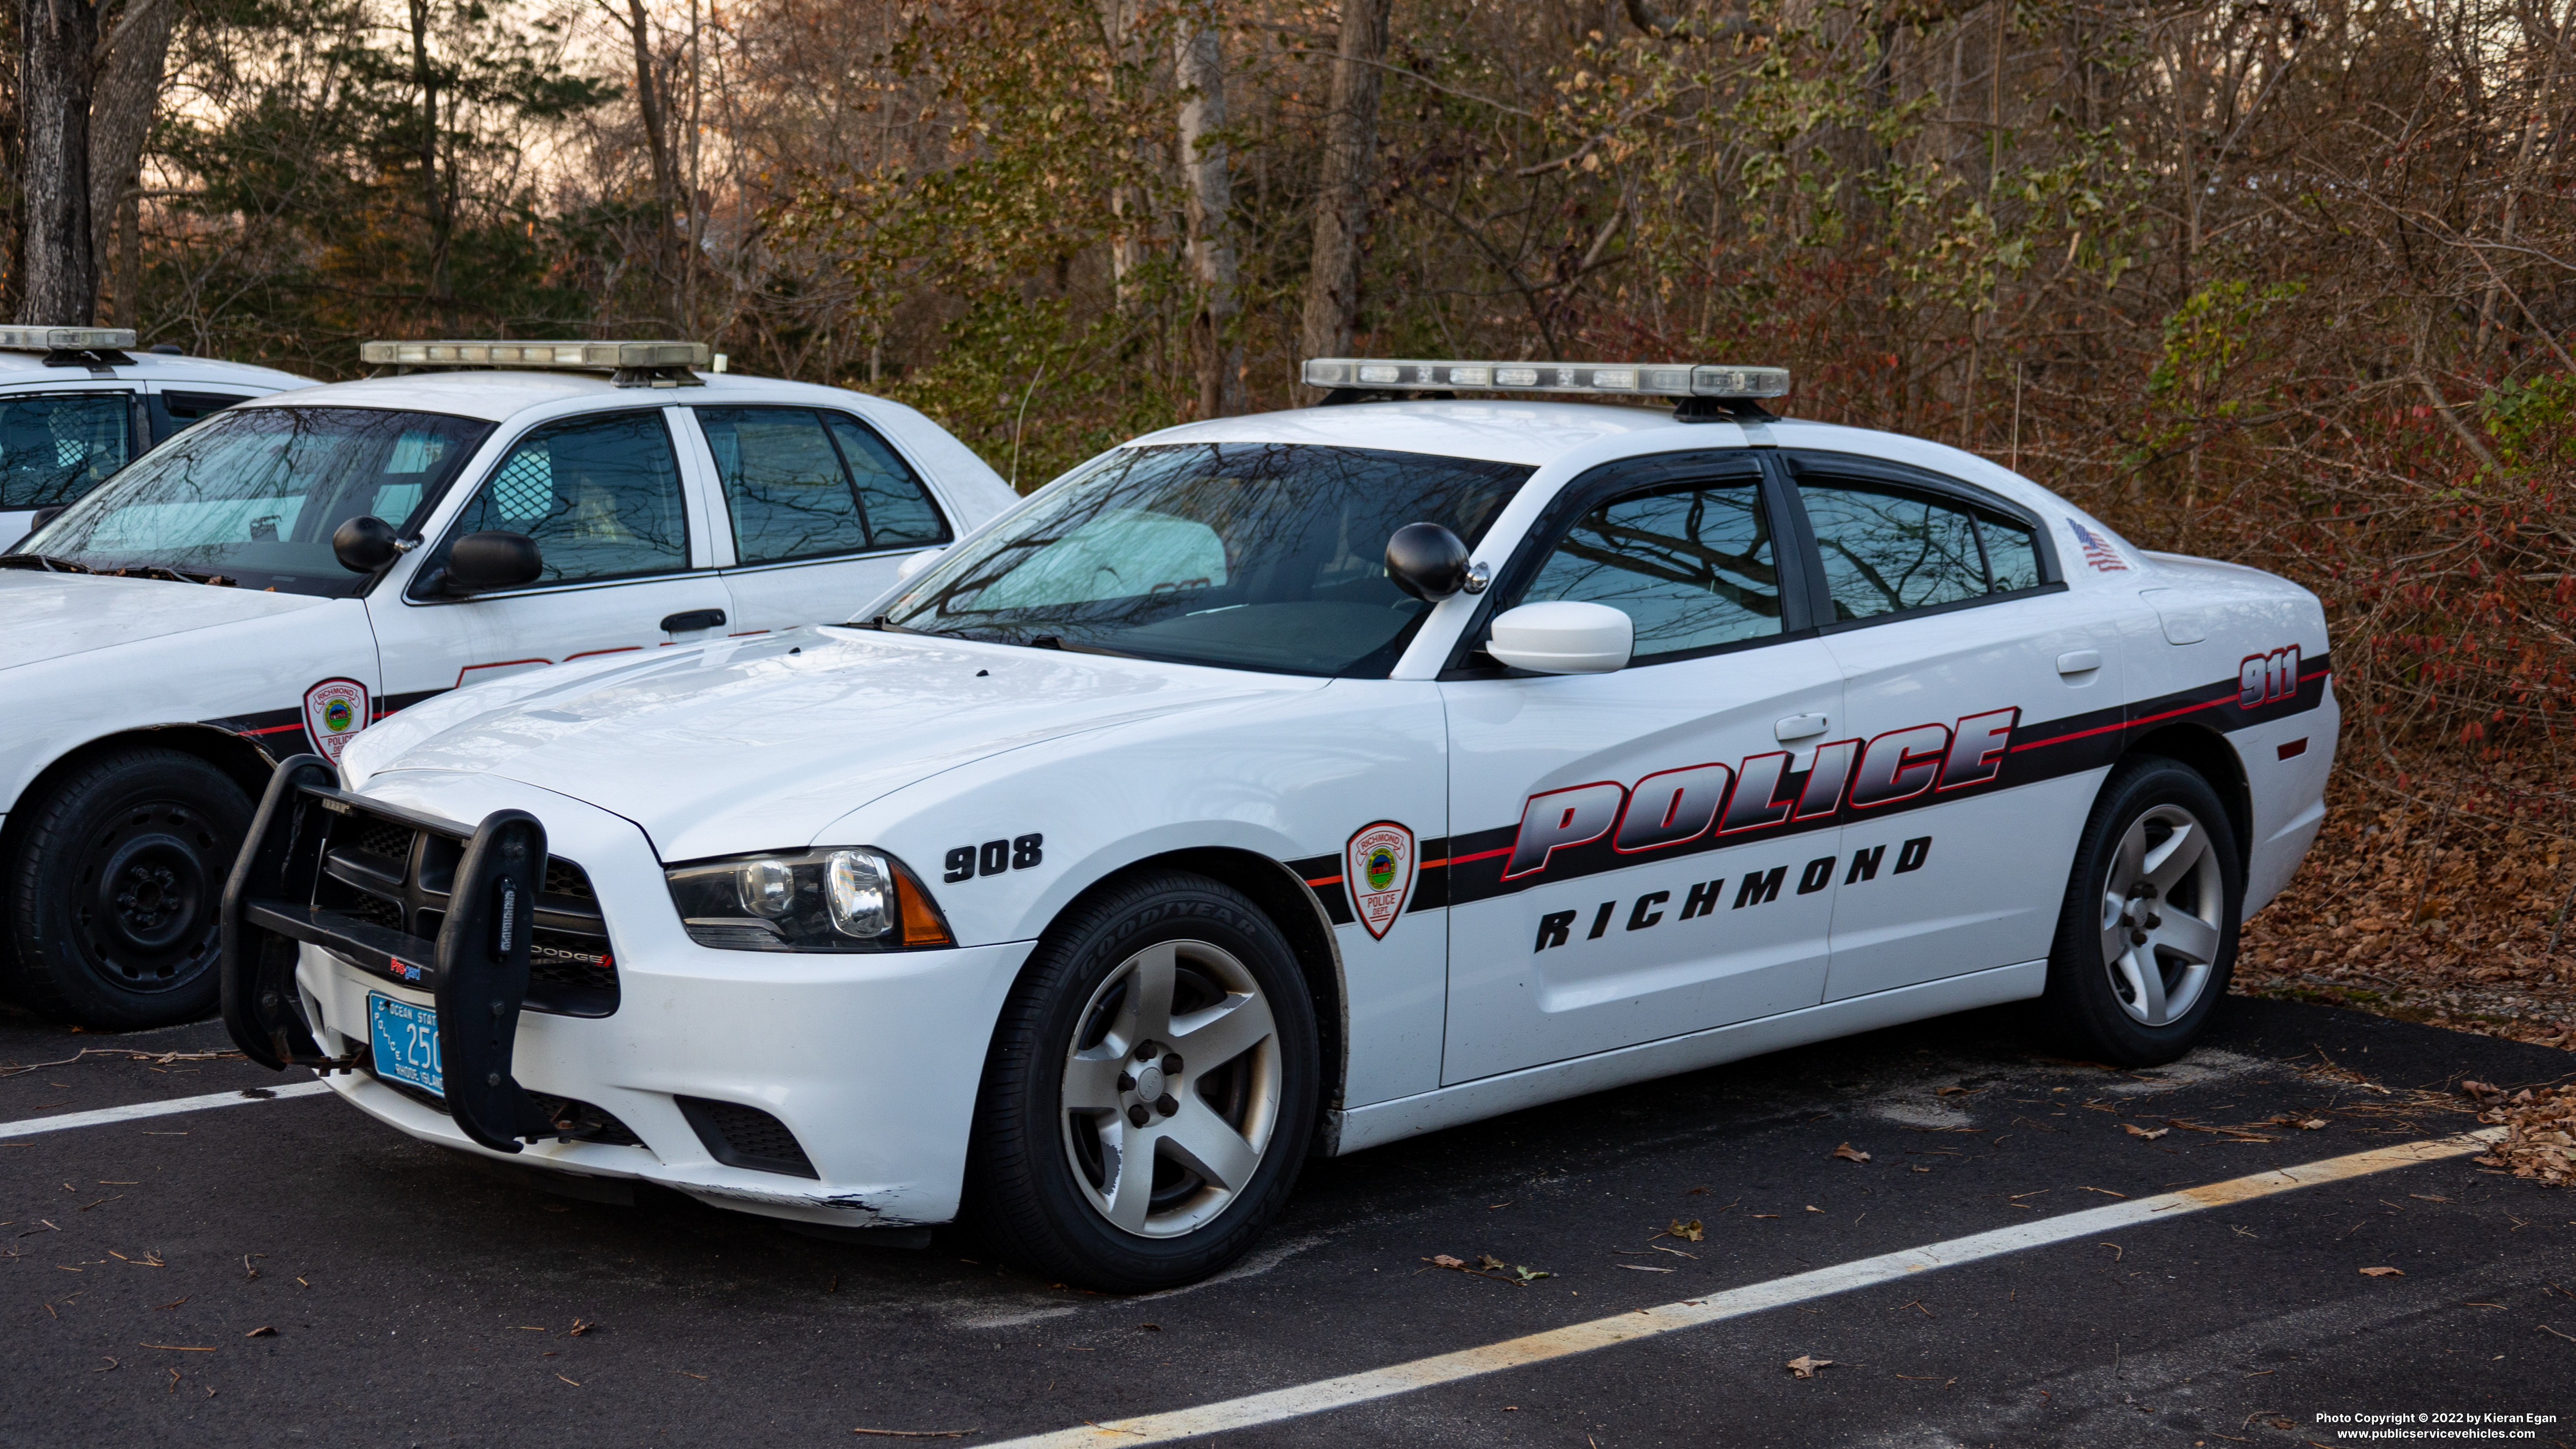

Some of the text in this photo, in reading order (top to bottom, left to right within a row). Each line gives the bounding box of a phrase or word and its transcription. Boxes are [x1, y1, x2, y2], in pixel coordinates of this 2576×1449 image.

[2238, 644, 2300, 709] 911
[317, 688, 354, 701] RICHMOND
[1500, 706, 2020, 881] POLICE
[1361, 834, 1400, 849] RICHMOND
[944, 833, 1043, 884] 908
[1367, 894, 1395, 909] POLICE
[1534, 837, 1932, 953] RICHMOND
[1372, 906, 1389, 916] DEPT.
[1079, 902, 1256, 980] GOODYEAR
[531, 945, 604, 964] DODGE
[390, 1004, 436, 1026] OCEAN STAT
[374, 1012, 401, 1061] POLICE
[395, 1064, 420, 1081] RHODE
